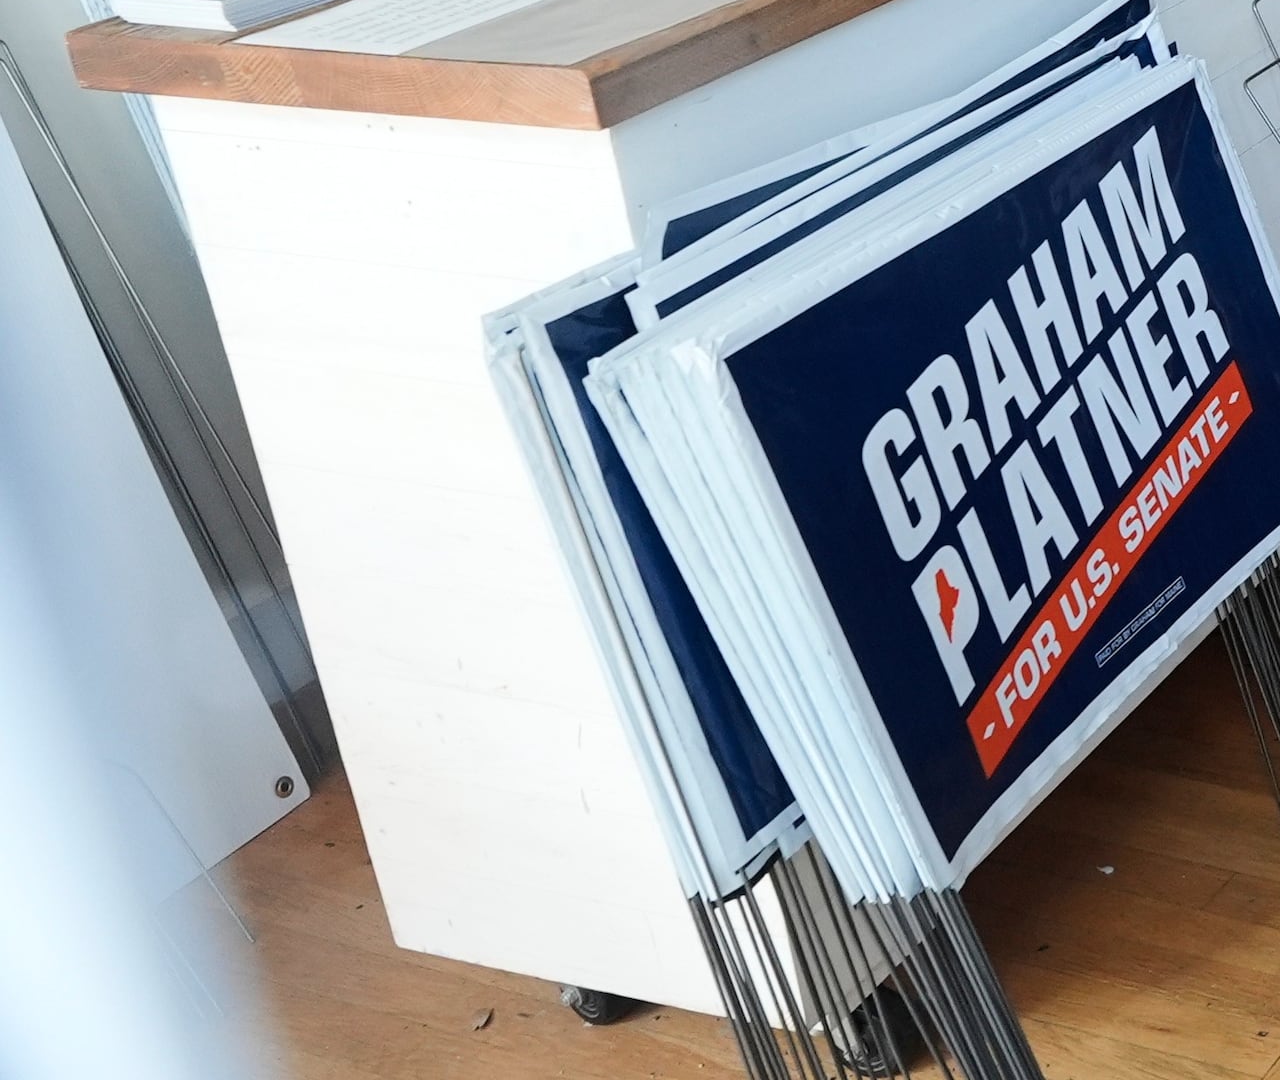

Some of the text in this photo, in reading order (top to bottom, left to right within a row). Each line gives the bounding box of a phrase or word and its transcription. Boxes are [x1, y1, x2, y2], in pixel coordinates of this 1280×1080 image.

[861, 125, 1186, 562] GRAHAM
[911, 252, 1231, 707] PLATNER
[996, 393, 1230, 731] FOR U.S. SENATE
[1111, 636, 1123, 650] FOR
[1155, 596, 1166, 610] FOR
